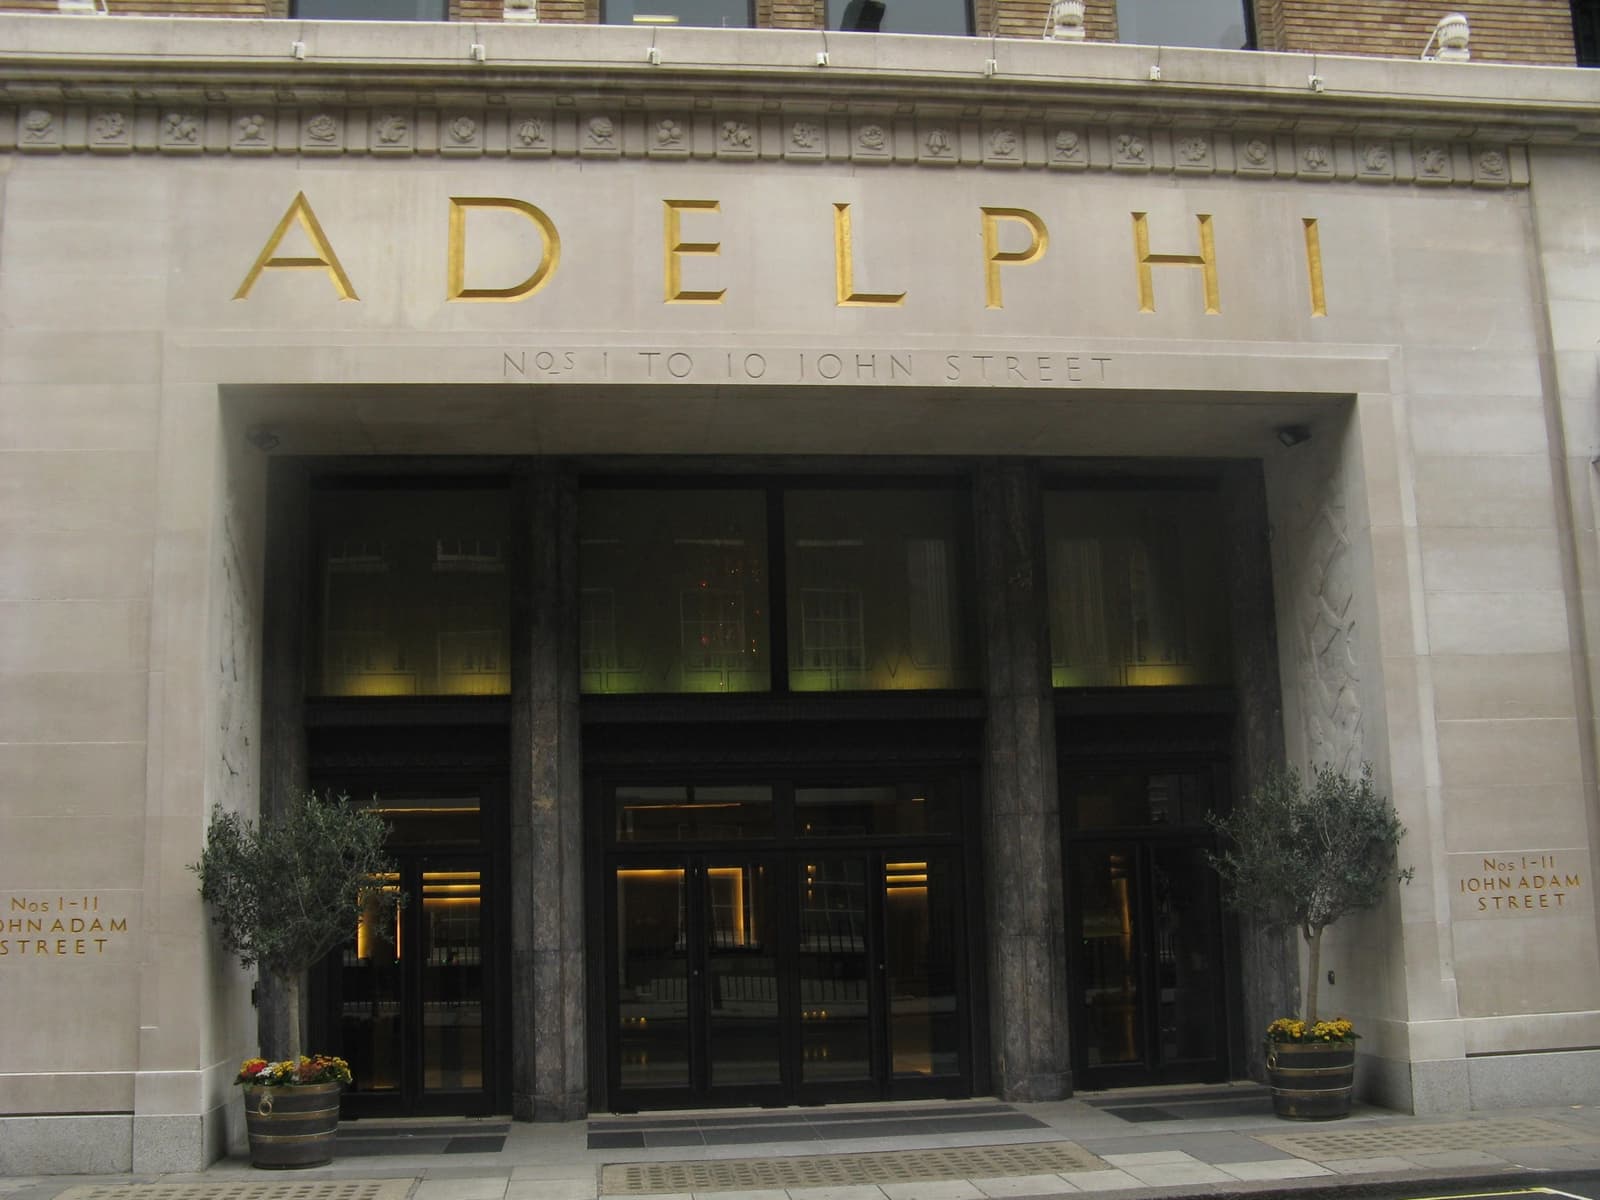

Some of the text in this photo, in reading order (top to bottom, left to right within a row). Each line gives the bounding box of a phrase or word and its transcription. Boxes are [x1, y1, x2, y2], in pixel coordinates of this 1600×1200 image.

[231, 190, 1327, 317] ADELPHI
[638, 351, 693, 378] TO
[797, 352, 913, 382] JOHN
[945, 354, 1113, 383] STREET
[1460, 874, 1580, 892] JOHN ADAM
[1478, 893, 1565, 911] STREET
[50, 917, 128, 933] ADAM
[0, 939, 108, 955] STREET
